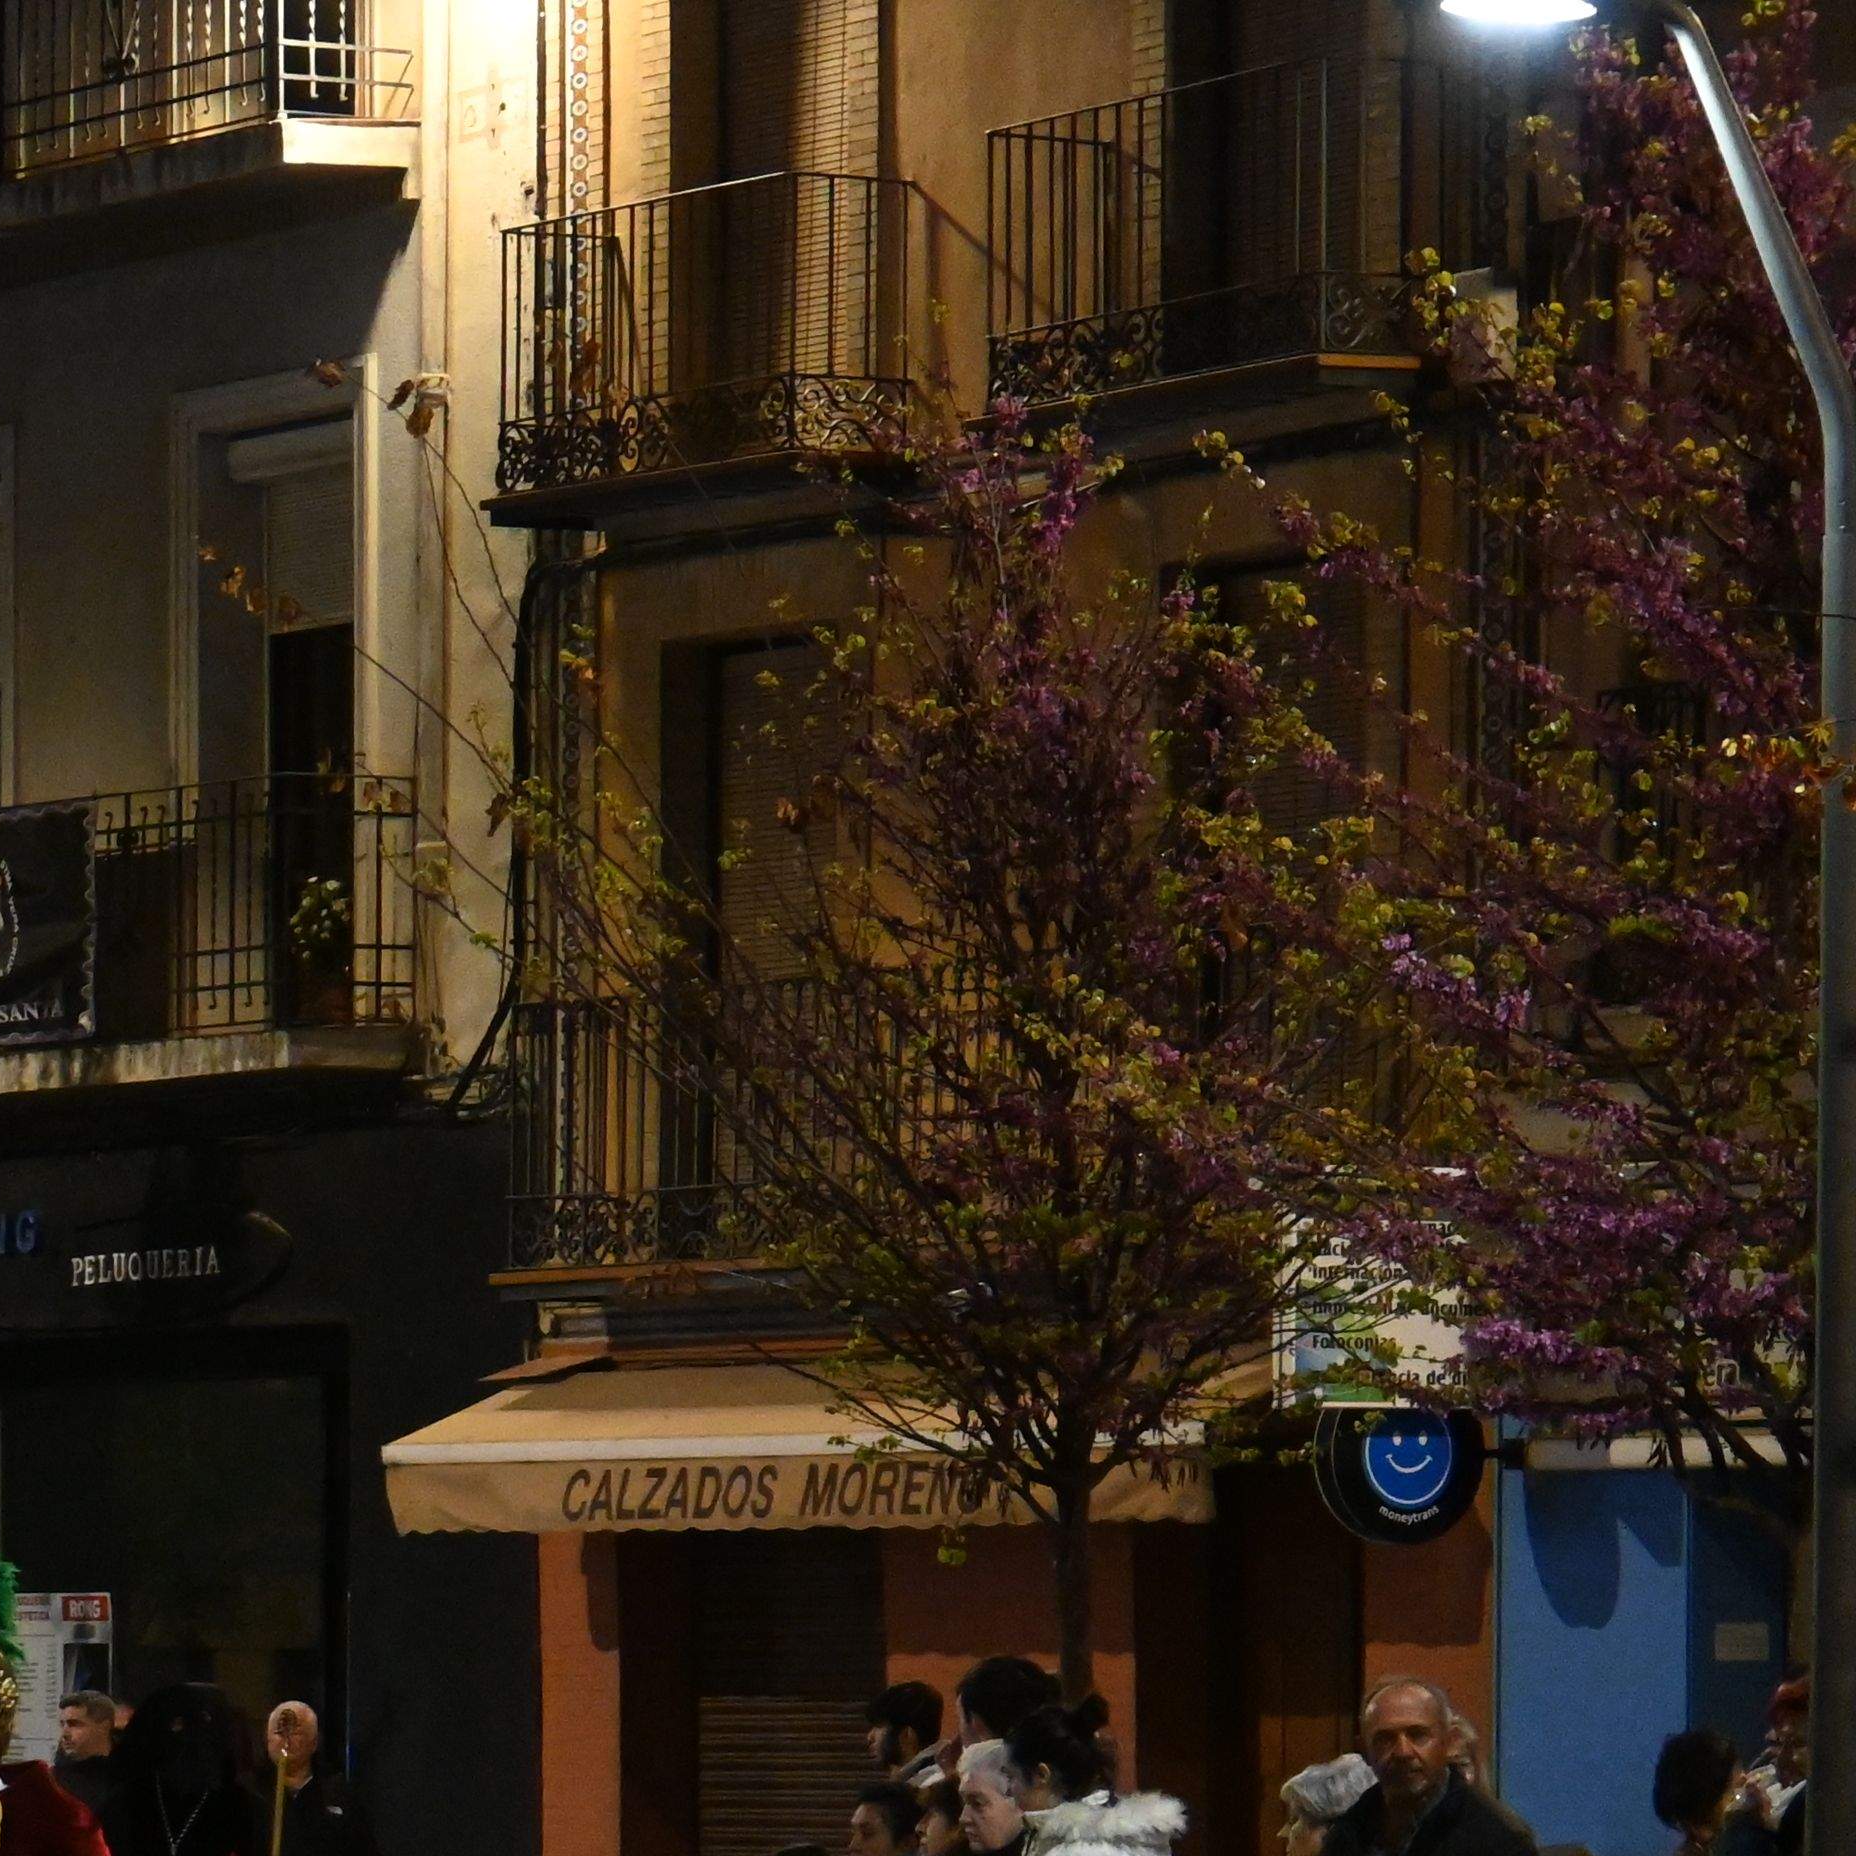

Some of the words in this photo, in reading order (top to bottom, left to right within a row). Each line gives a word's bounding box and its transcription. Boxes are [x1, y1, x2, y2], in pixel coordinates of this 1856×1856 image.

[70, 1245, 221, 1288] PELUQUERIA
[561, 1464, 778, 1522] CALZADOS
[1378, 1504, 1440, 1526] moneytrans
